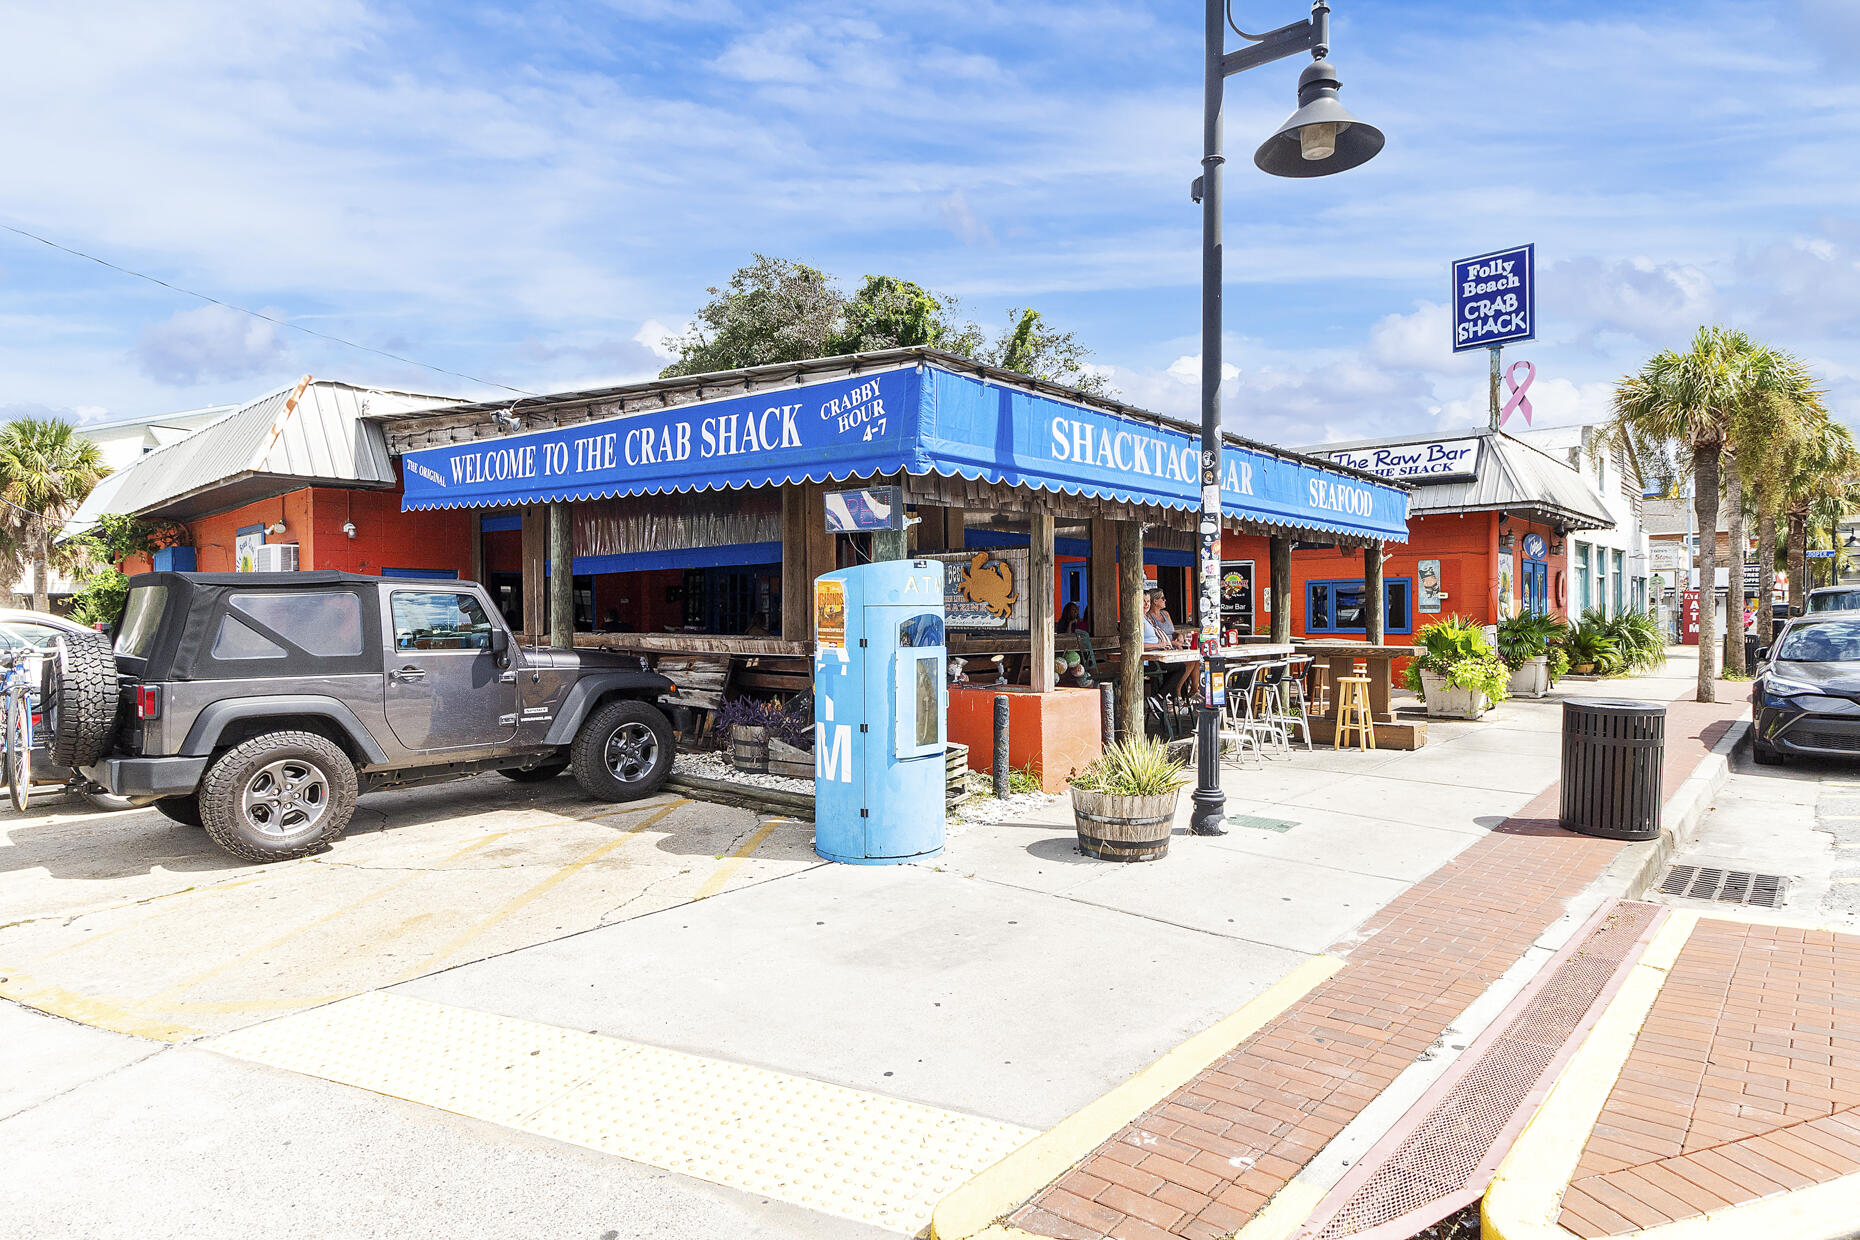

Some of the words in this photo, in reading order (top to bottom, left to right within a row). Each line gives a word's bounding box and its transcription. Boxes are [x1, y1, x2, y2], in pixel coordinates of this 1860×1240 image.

[1467, 259, 1515, 281] Folly
[1462, 273, 1520, 297] Beach
[1464, 293, 1518, 320] CRAB
[1458, 311, 1526, 342] SHACK
[820, 377, 881, 420] CRABBY
[837, 399, 886, 434] HOUR
[862, 417, 887, 442] 4-7
[449, 445, 537, 486] WELCOME
[542, 440, 569, 476] TO
[574, 431, 617, 473] THE
[624, 422, 691, 466] CRAB
[700, 402, 803, 457] SHACK
[1051, 416, 1255, 496] SHACKTACAR
[1333, 453, 1369, 469] The
[1372, 449, 1422, 468] Raw
[1426, 444, 1472, 463] Bar
[406, 458, 418, 474] THE
[419, 464, 447, 488] ORIGINAL
[1398, 462, 1454, 476] SHACK
[1308, 477, 1373, 518] SEAFOOD
[903, 575, 943, 594] ATM
